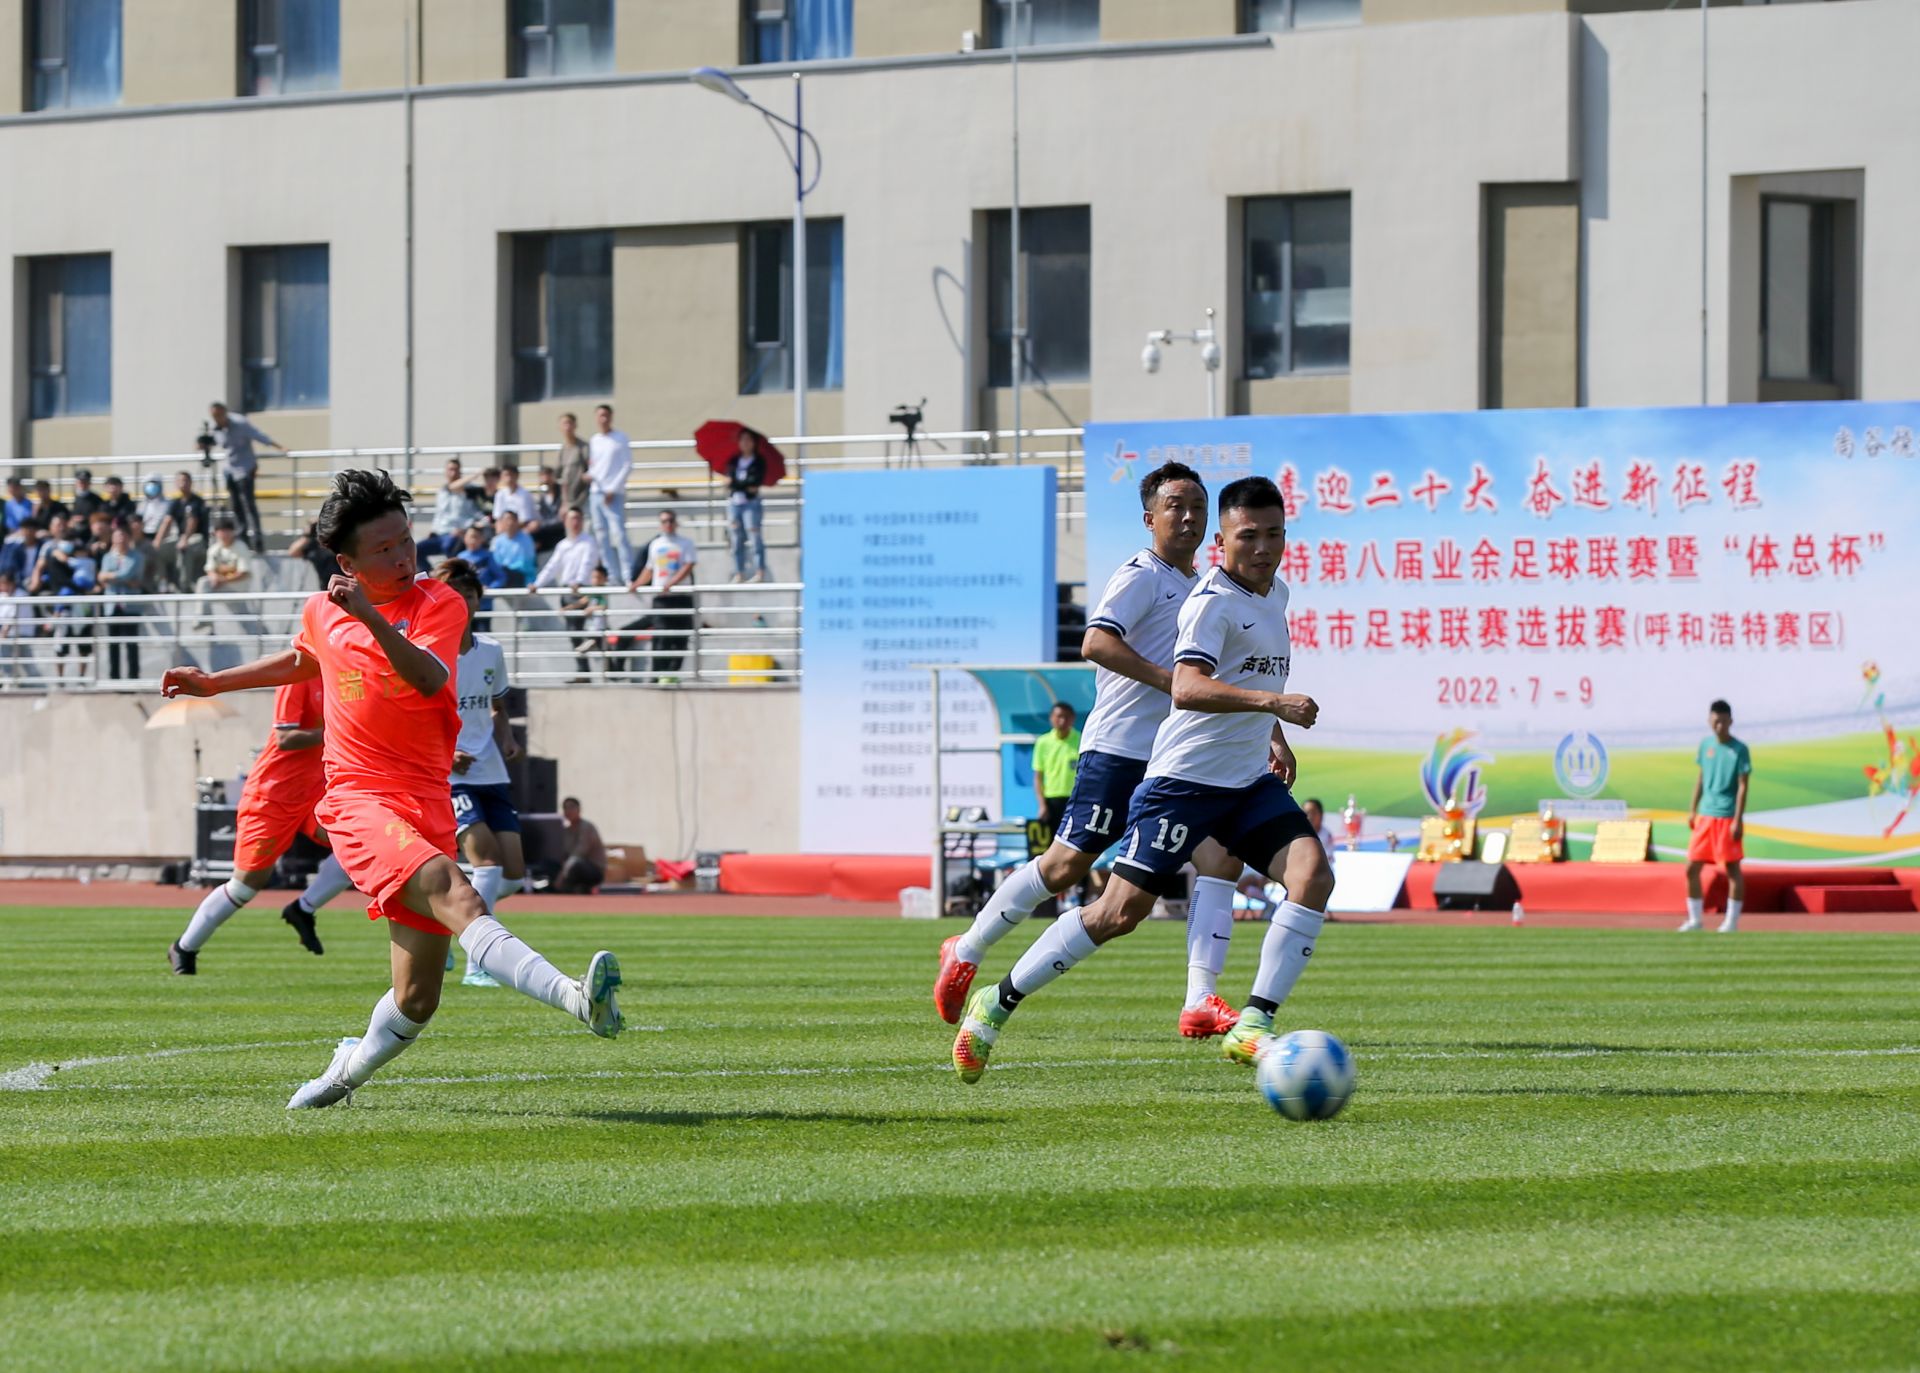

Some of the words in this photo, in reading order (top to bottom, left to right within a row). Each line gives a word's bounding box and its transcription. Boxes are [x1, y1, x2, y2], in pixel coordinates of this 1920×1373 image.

[1279, 466, 1495, 517] 喜迎二十大
[1527, 459, 1759, 514] 奋进新征程
[1084, 803, 1113, 835] 11
[1150, 817, 1189, 854] 19
